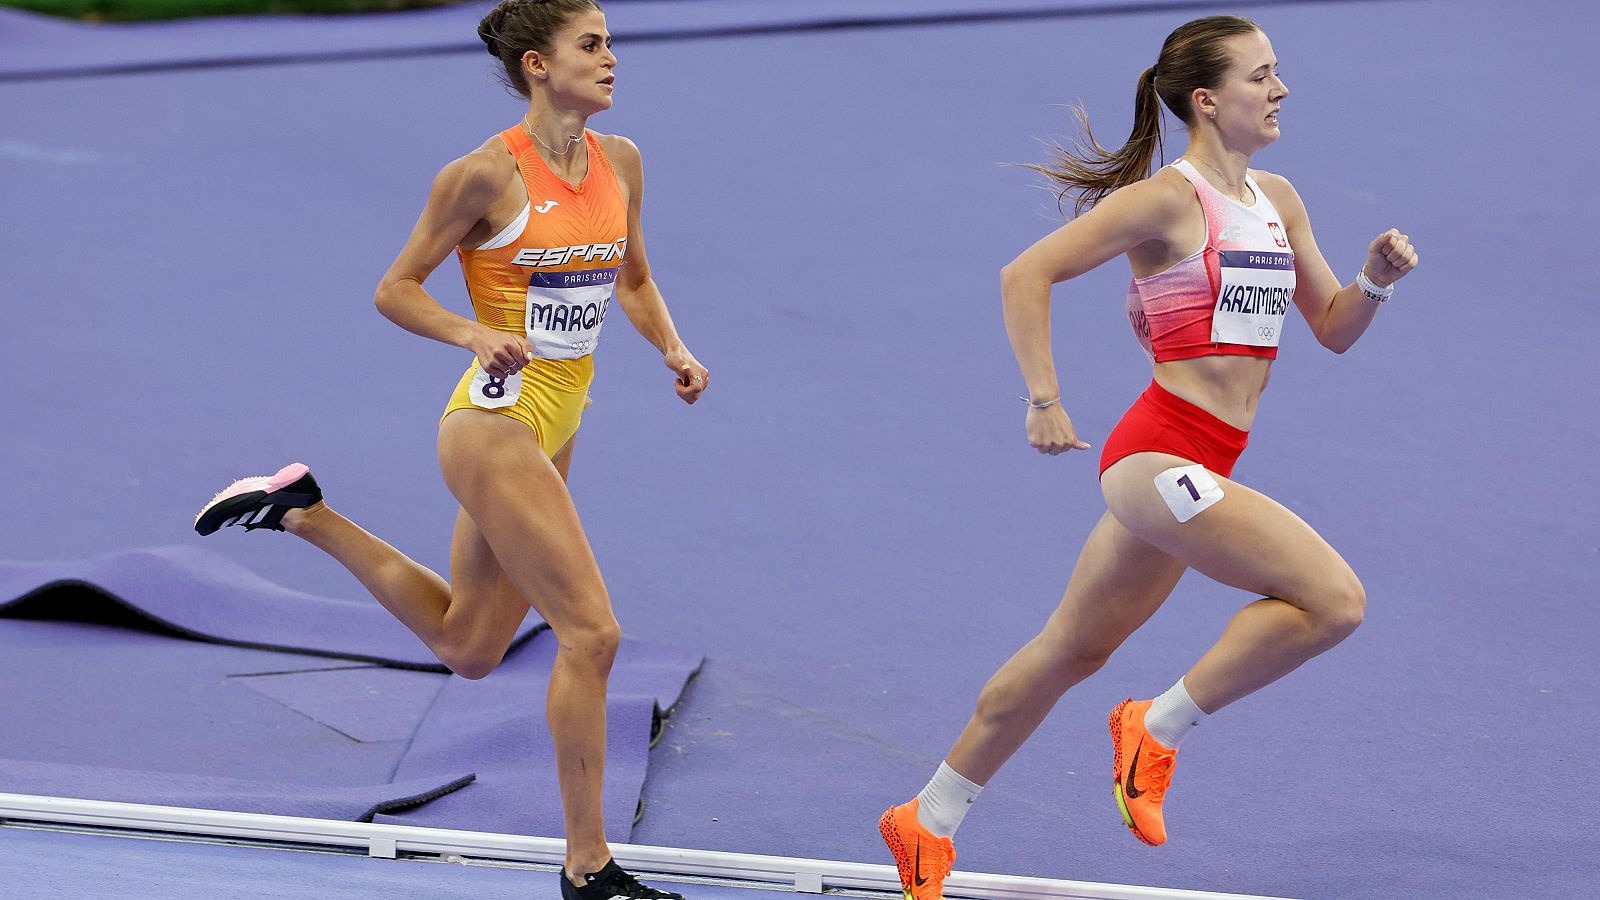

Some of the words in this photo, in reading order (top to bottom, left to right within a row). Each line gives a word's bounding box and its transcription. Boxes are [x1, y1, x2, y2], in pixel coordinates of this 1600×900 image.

[1249, 255, 1272, 265] PARIS
[564, 273, 590, 284] PARIS
[592, 271, 613, 281] 2024
[482, 373, 505, 399] 8
[1176, 473, 1201, 502] 1
